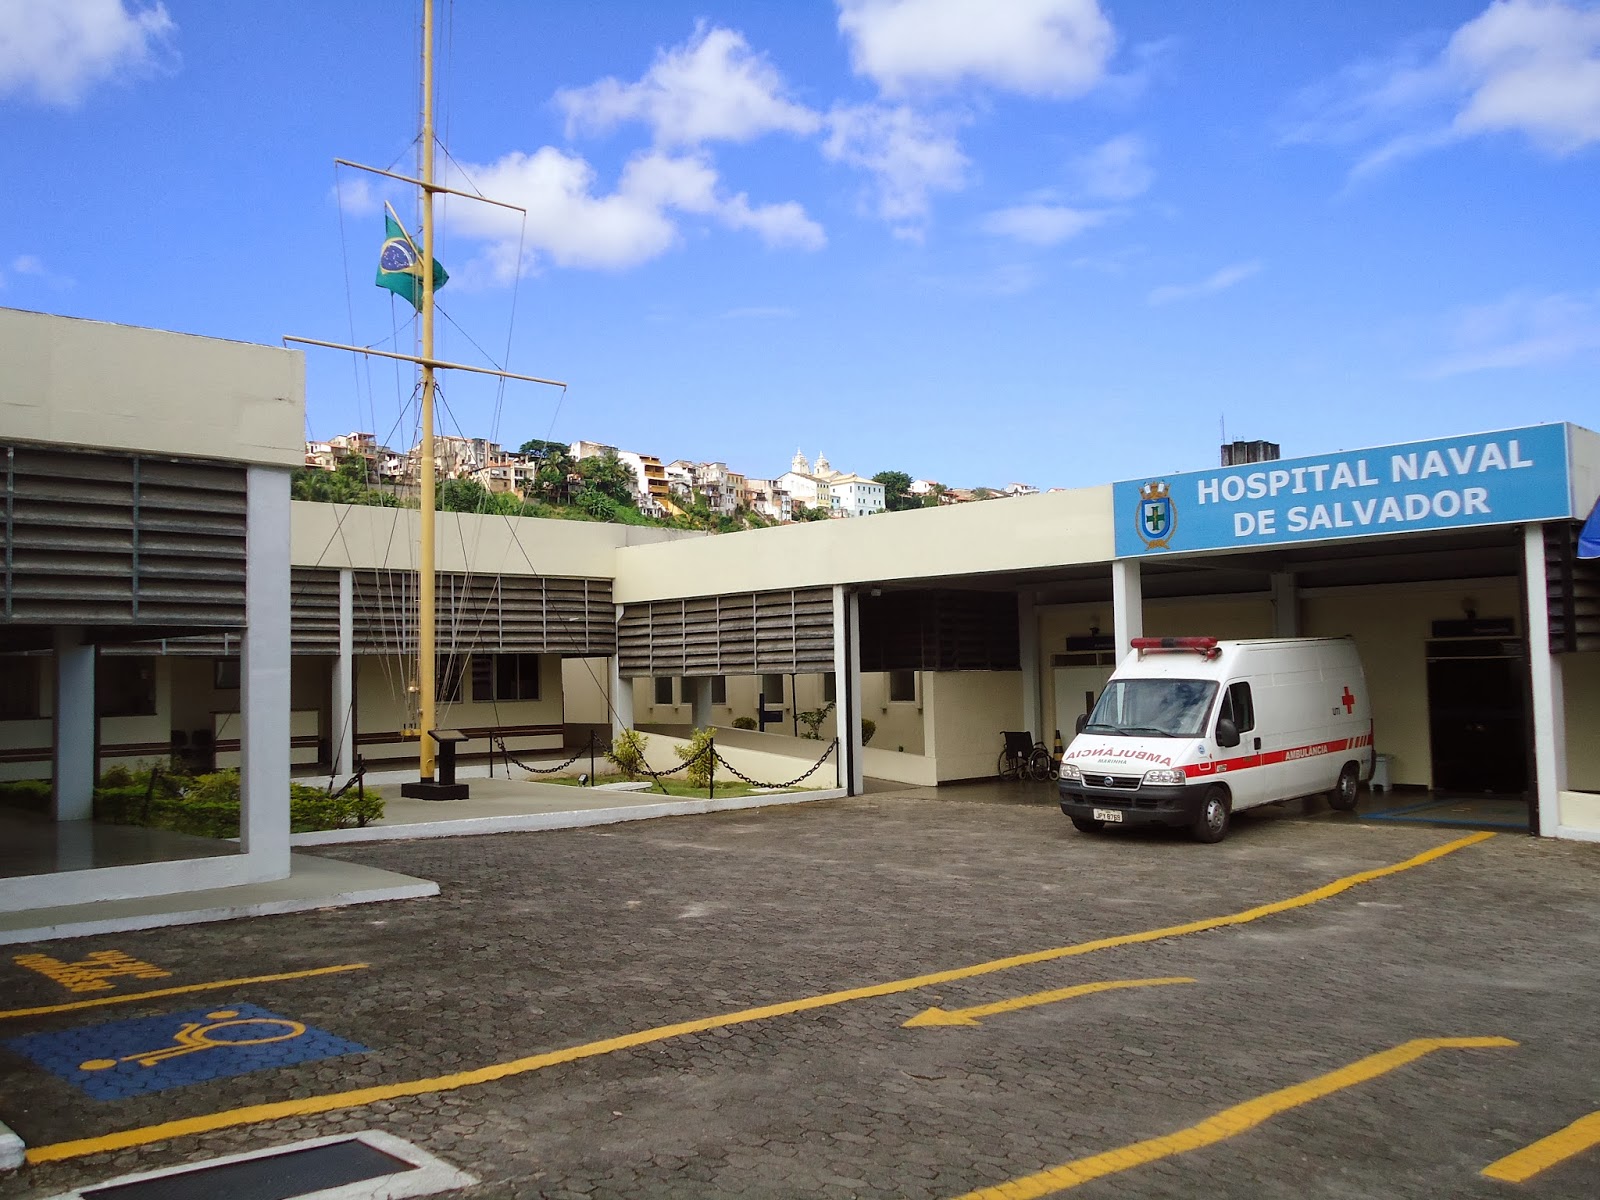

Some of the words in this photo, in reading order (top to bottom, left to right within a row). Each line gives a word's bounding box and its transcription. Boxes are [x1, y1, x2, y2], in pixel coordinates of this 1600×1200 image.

[1198, 459, 1379, 505] HOSPITAL
[1391, 439, 1534, 483] NAVAL
[1234, 509, 1276, 537] DE
[1287, 487, 1492, 532] SALVADOR
